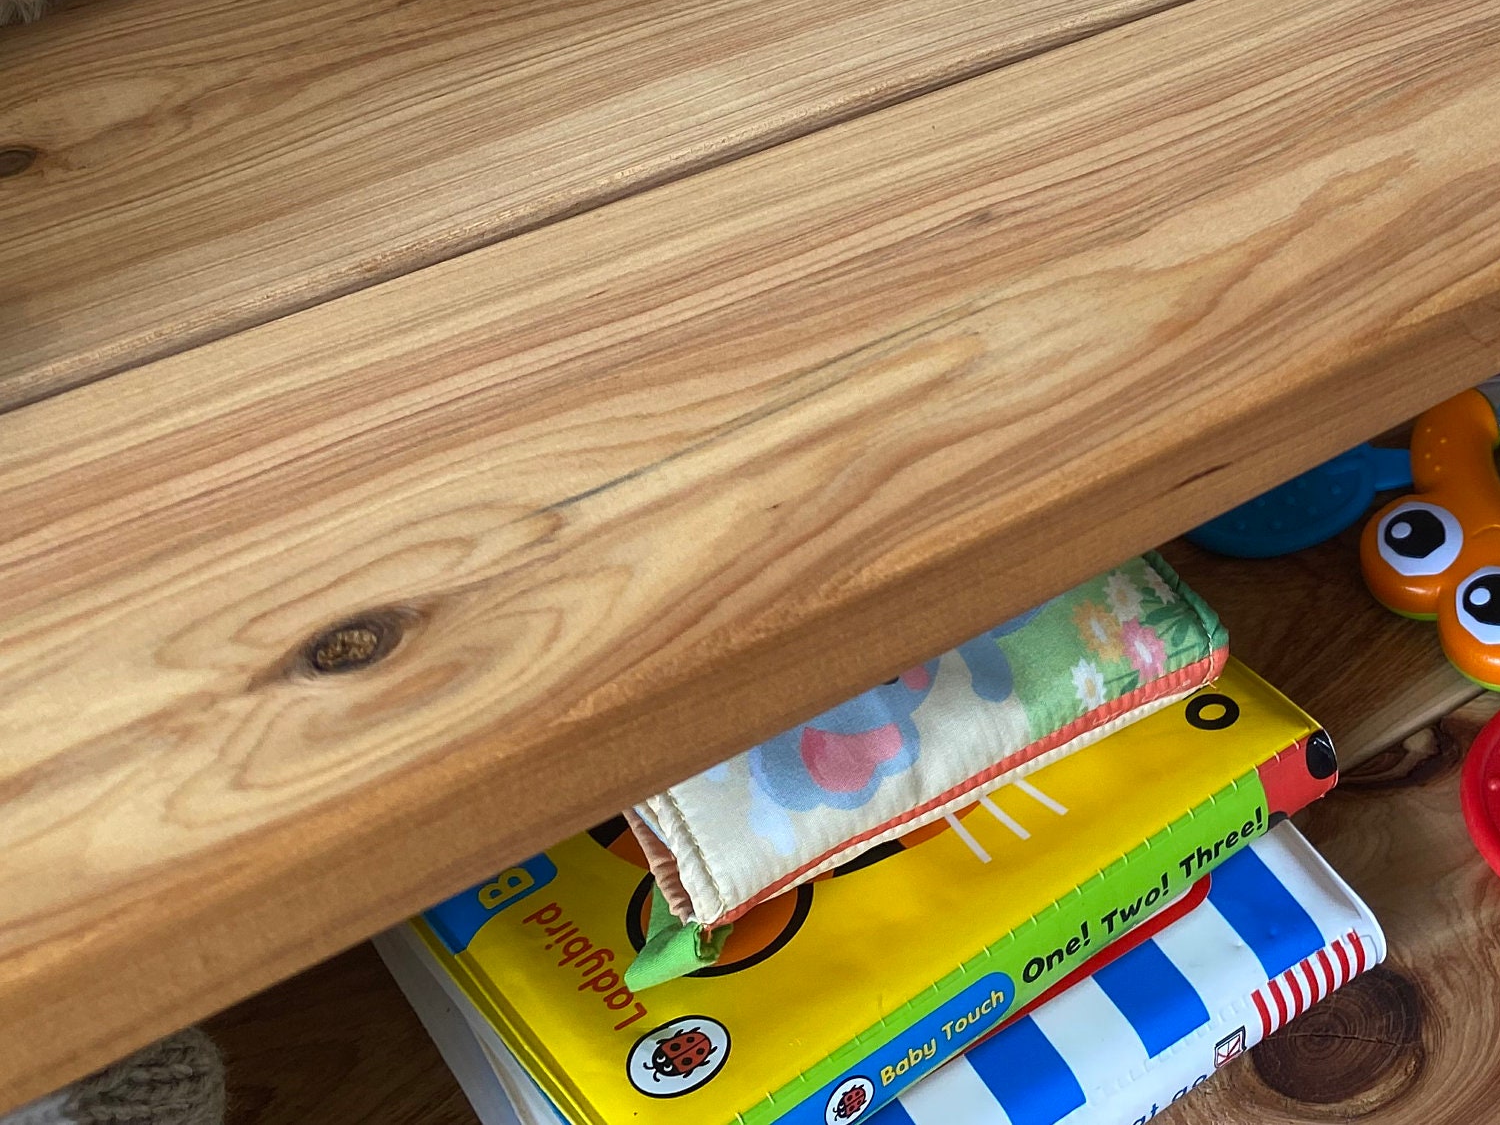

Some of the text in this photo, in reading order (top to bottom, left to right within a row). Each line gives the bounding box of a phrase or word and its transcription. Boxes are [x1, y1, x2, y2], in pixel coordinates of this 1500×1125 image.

[522, 902, 648, 1032] Ladybird
[879, 806, 1263, 1087] Baby Touch One! Two! Three!
